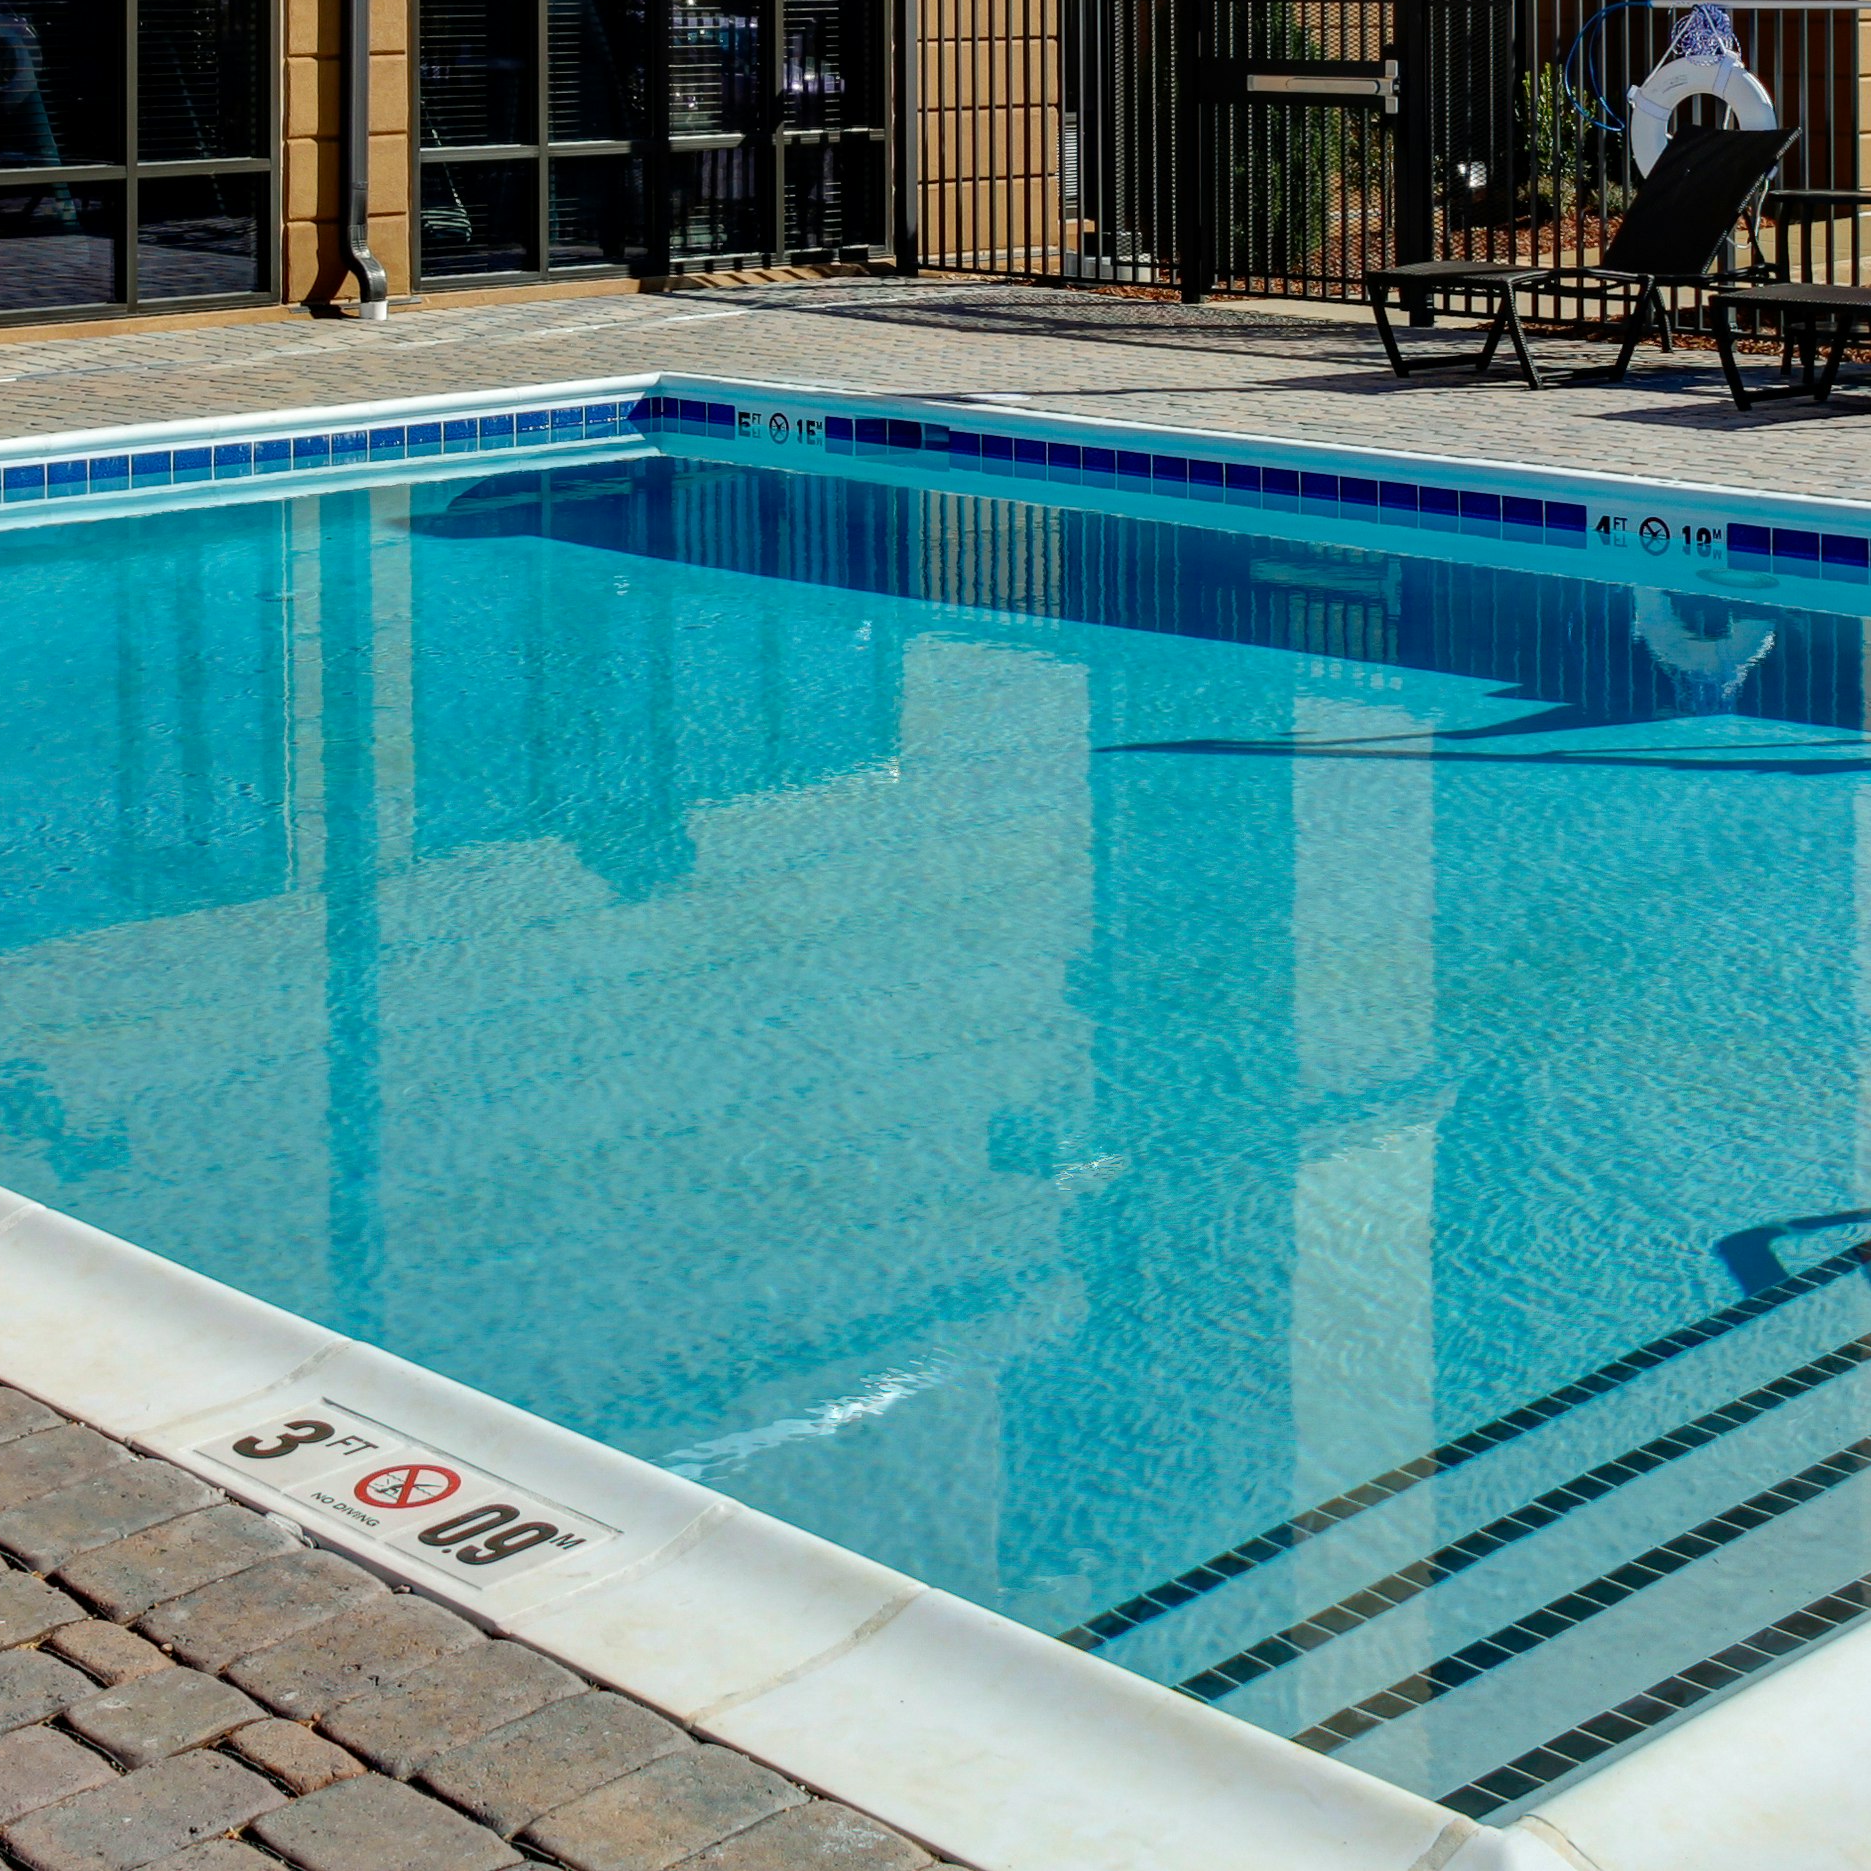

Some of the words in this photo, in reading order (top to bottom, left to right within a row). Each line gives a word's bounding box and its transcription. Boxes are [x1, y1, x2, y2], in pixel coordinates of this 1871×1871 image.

[1613, 517, 1628, 531] FT
[232, 1419, 335, 1459] 3
[326, 1434, 379, 1456] FT
[418, 1503, 559, 1565] 0.9
[549, 1533, 587, 1550] M
[311, 1491, 335, 1506] NO
[333, 1500, 381, 1528] DIVING
